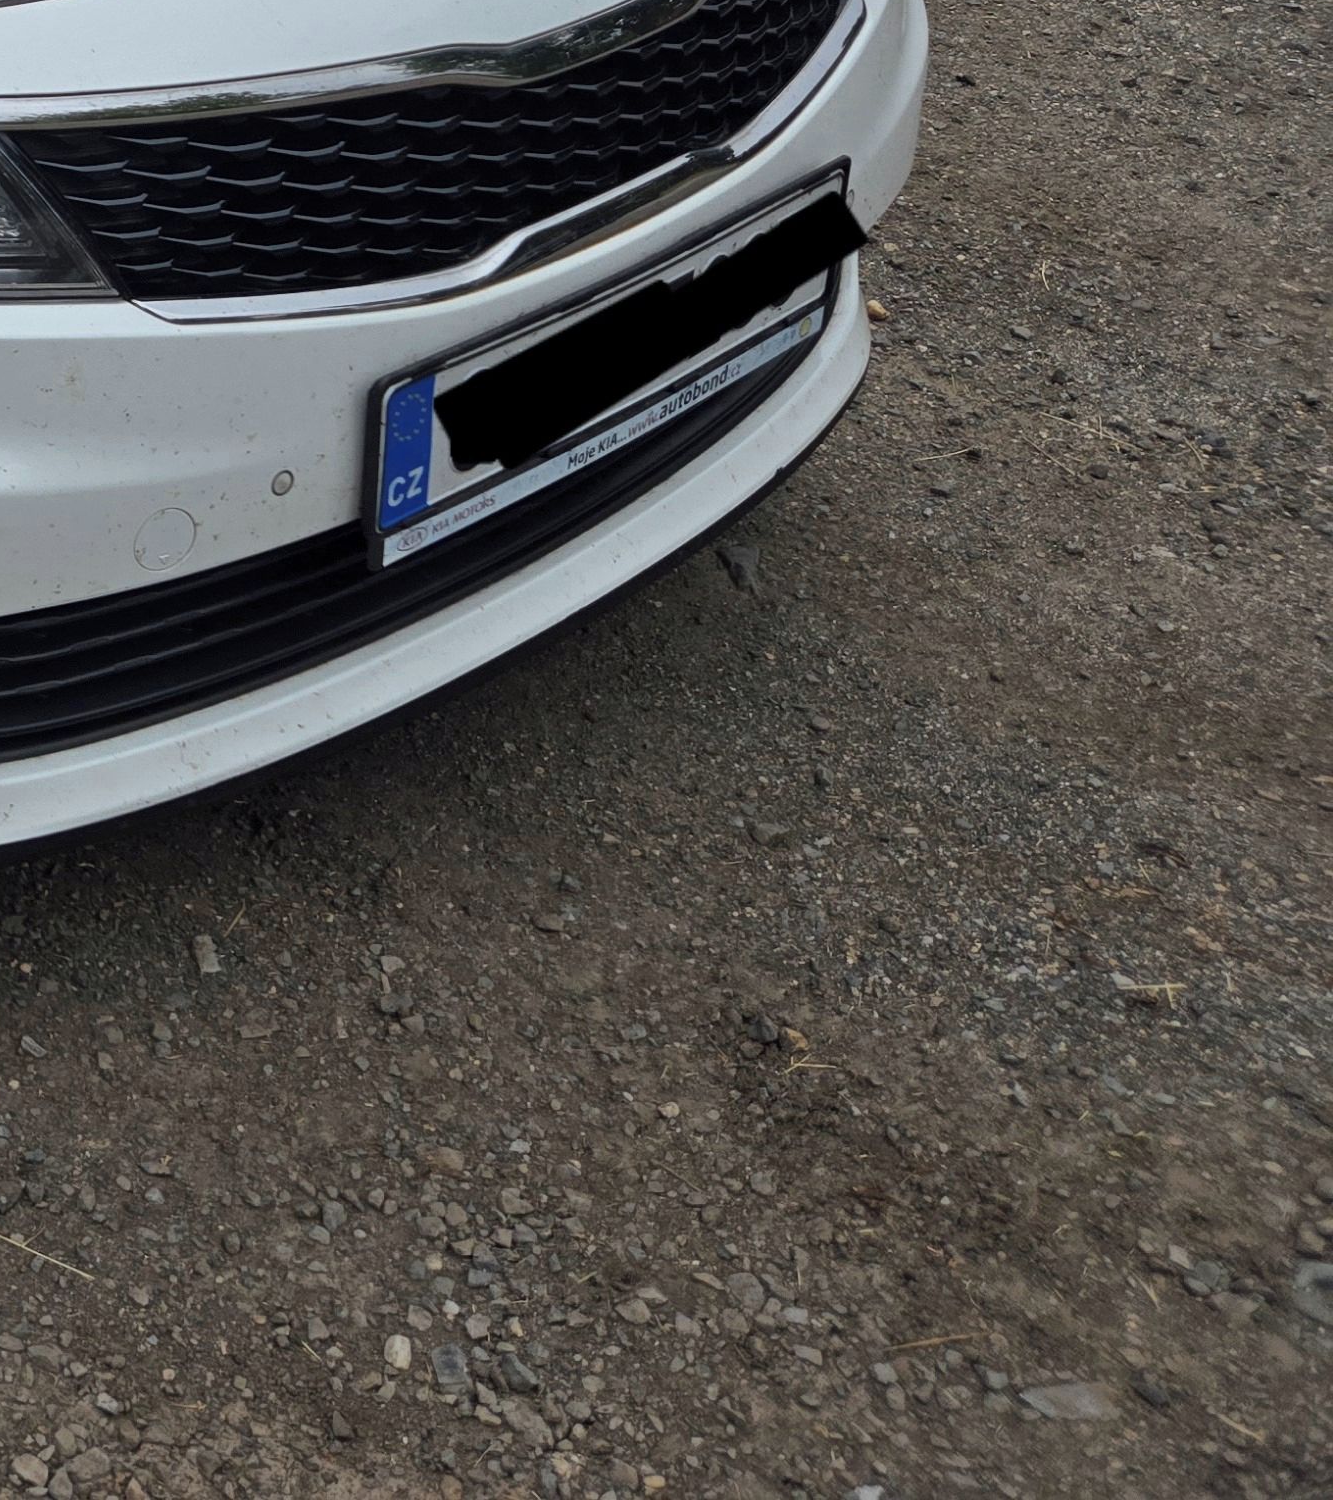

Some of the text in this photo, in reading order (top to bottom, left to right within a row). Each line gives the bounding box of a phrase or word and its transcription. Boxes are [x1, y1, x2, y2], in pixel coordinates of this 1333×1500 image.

[566, 445, 596, 470] Moje
[387, 465, 424, 507] CZ
[431, 494, 497, 535] KIA MOTORS
[401, 530, 424, 548] KIA
